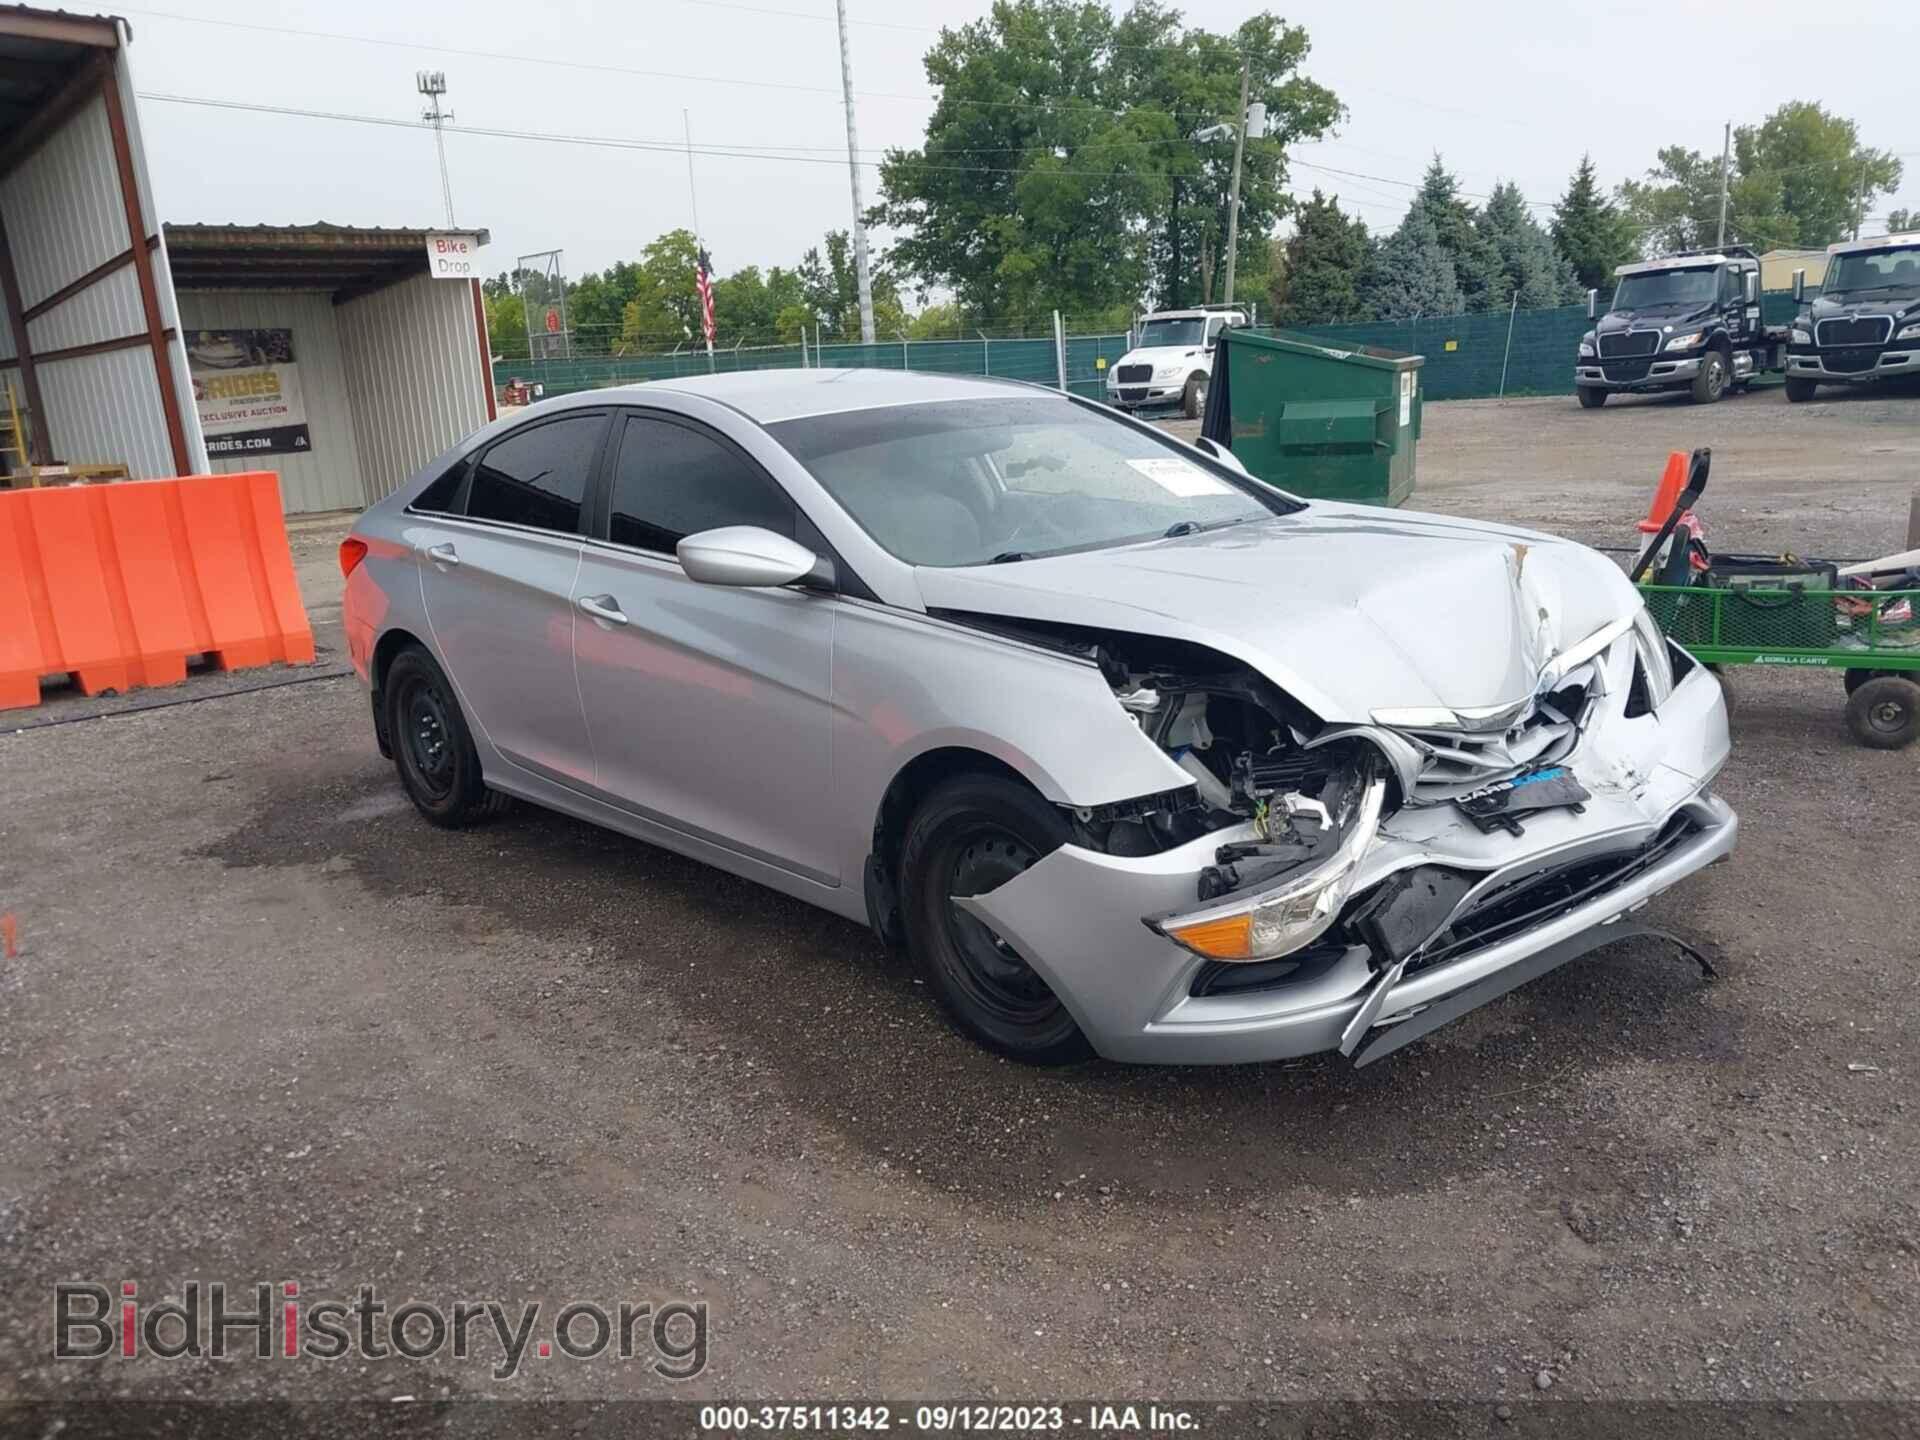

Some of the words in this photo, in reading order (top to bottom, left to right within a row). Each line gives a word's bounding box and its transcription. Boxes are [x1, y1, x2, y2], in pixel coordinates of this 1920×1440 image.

[436, 239, 467, 253] Bike
[438, 258, 471, 274] Drop
[208, 372, 280, 398] RIDES
[250, 406, 288, 416] AUCTION
[205, 438, 272, 451] RIDES.COM
